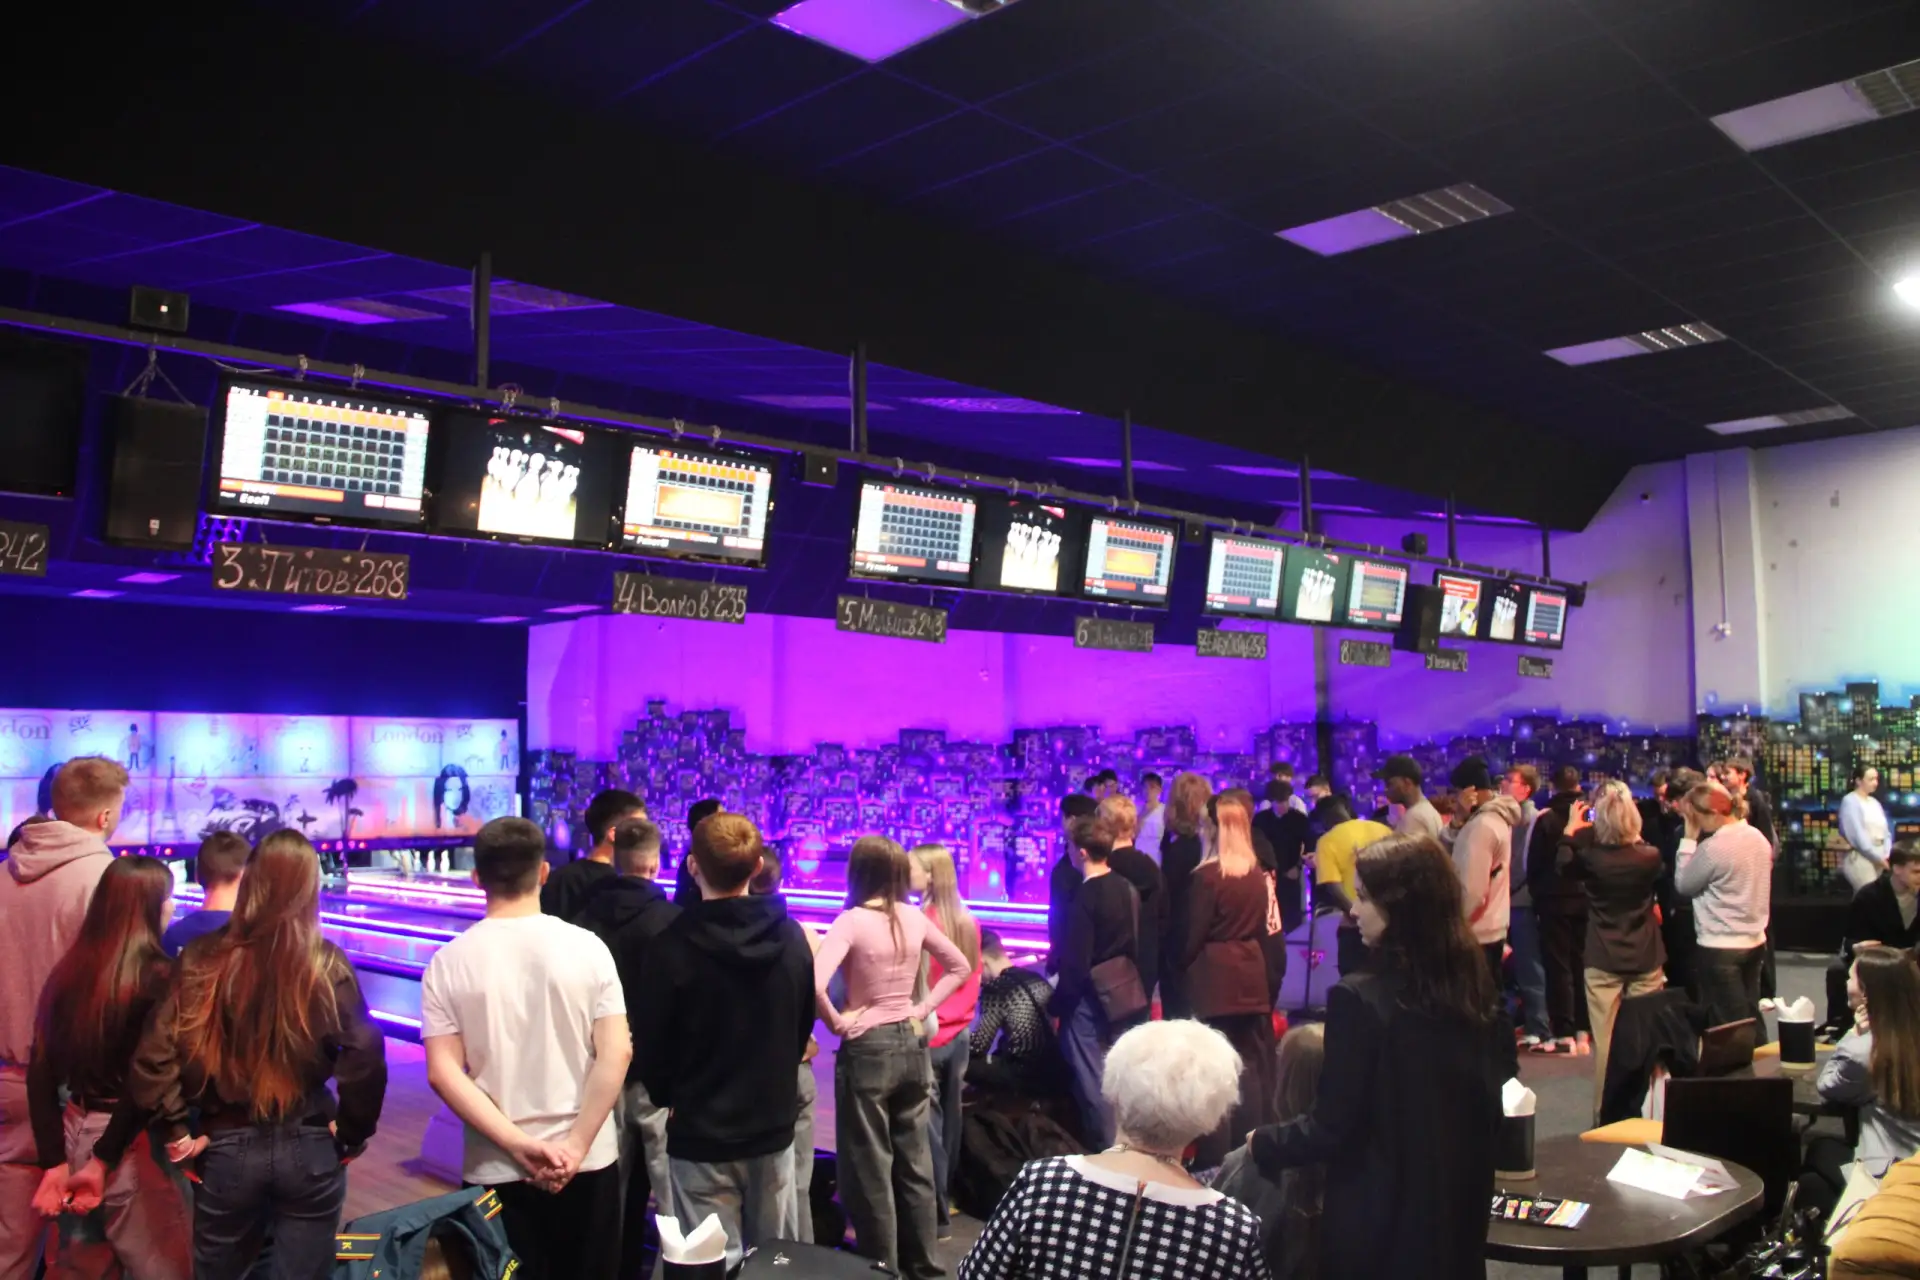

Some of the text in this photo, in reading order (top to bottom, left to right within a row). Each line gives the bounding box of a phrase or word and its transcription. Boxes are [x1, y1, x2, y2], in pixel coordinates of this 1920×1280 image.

[354, 558, 406, 598] 268
[618, 574, 636, 613] 4
[370, 724, 444, 744] London
